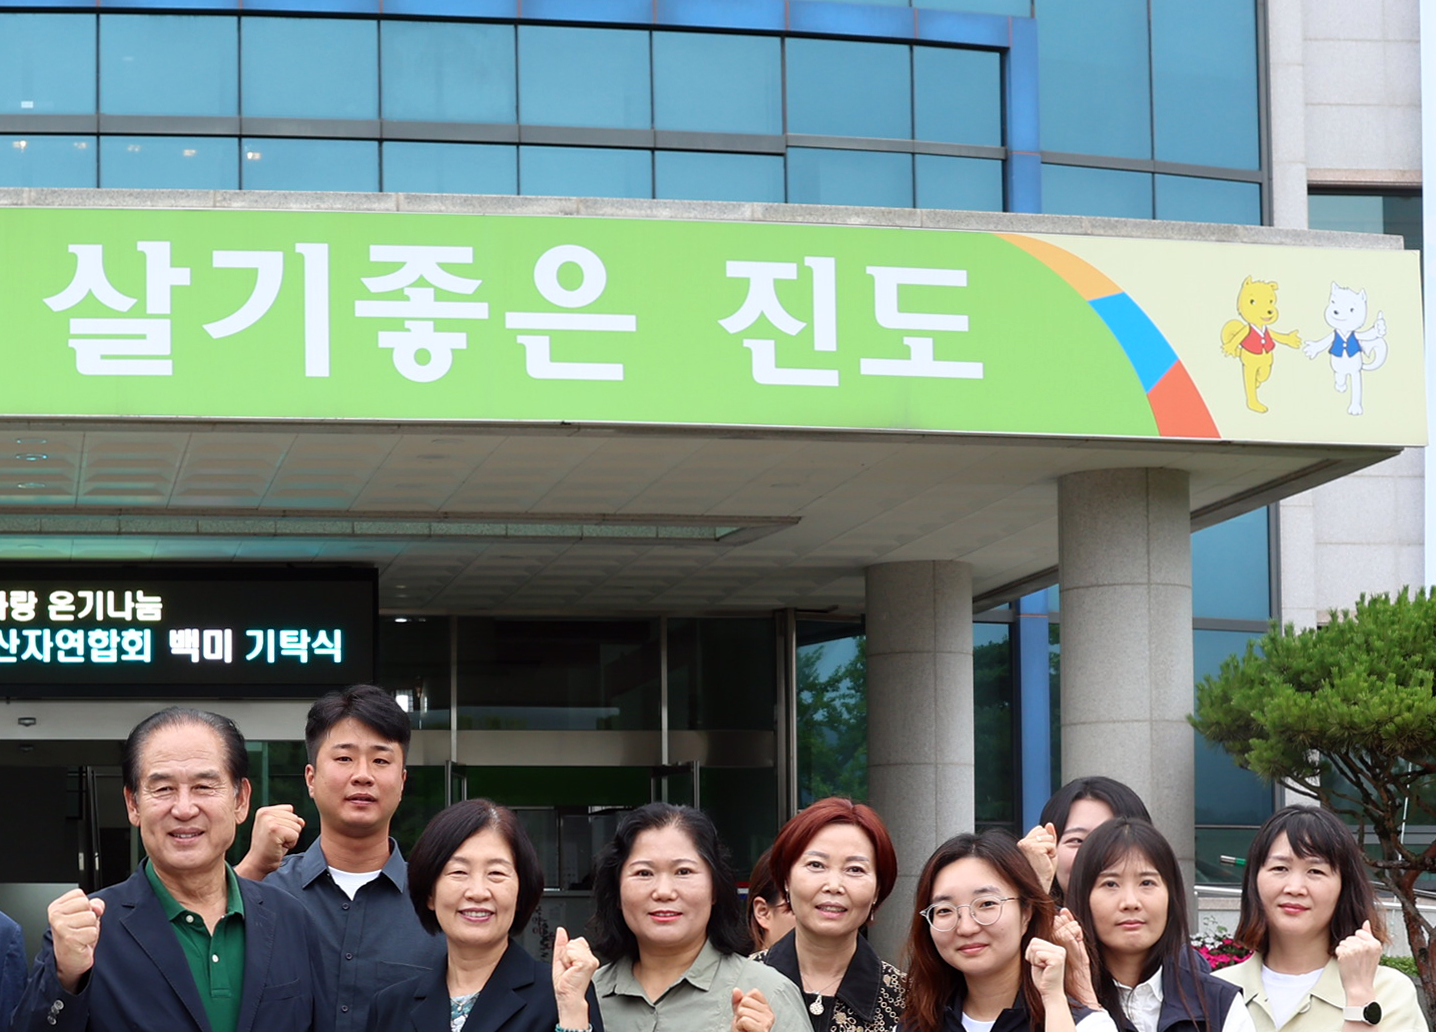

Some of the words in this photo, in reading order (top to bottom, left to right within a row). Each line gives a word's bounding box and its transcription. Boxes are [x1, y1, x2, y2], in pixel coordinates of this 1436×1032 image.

[42, 238, 637, 381] 살기좋은
[718, 256, 986, 388] 진도
[48, 589, 164, 622] 온기나눔
[169, 629, 233, 665] 백미
[246, 628, 342, 665] 기탁식
